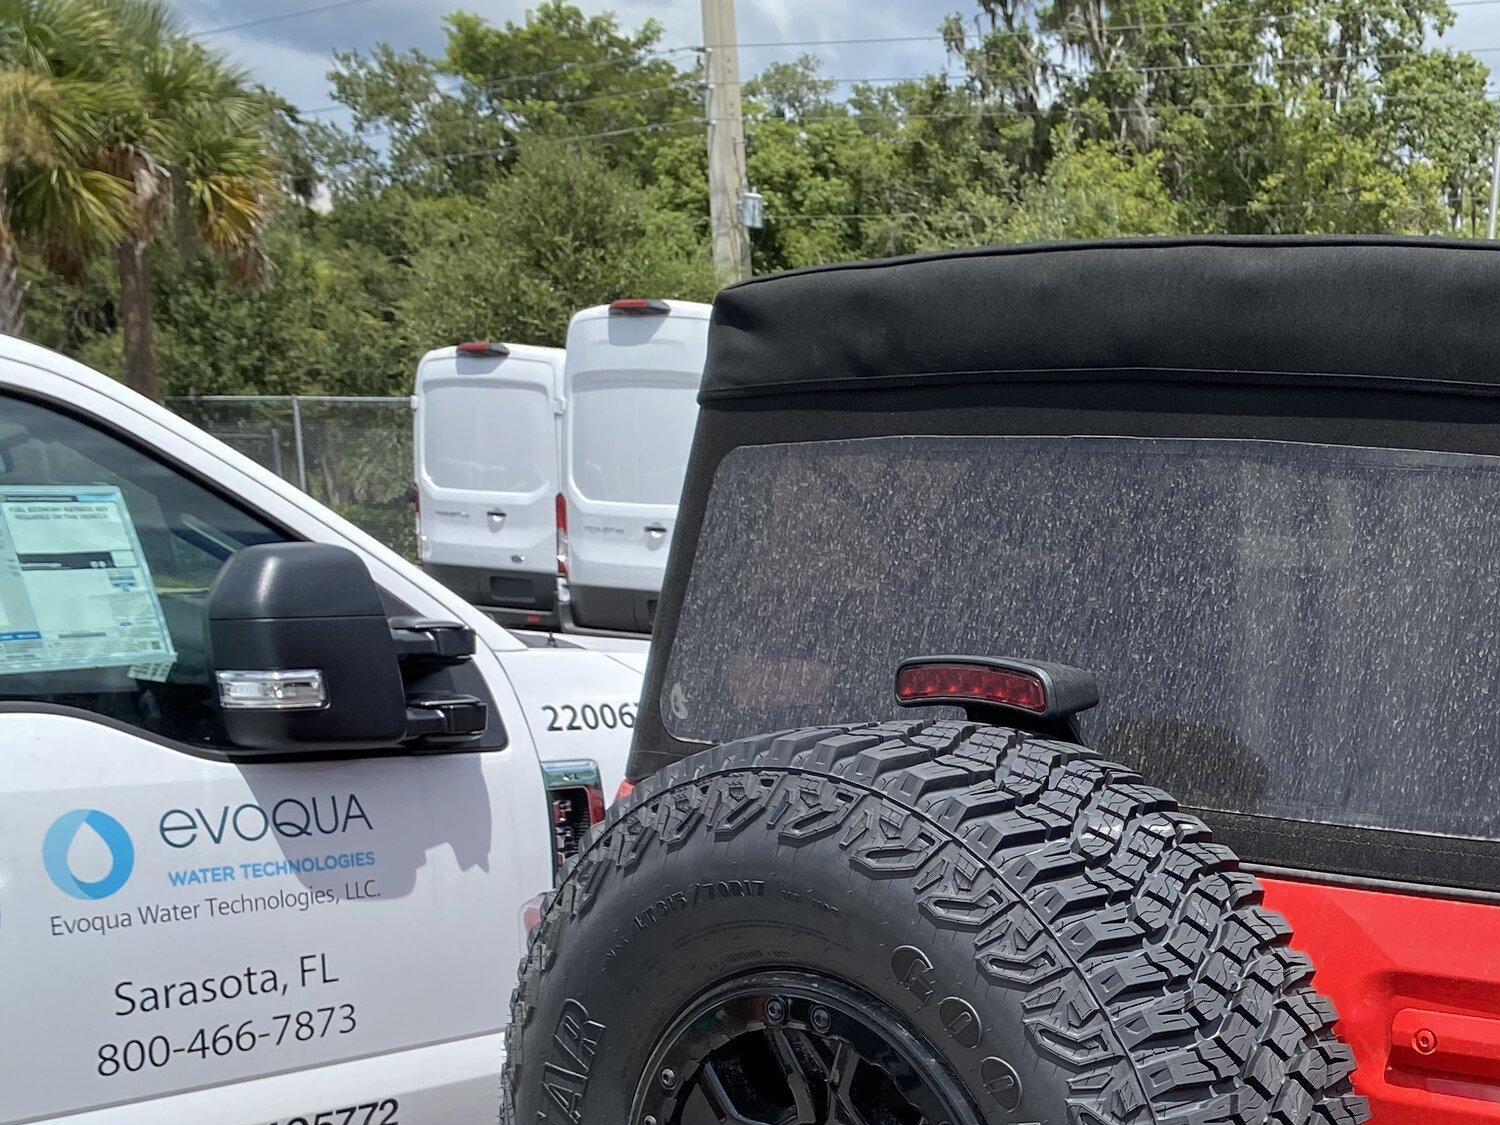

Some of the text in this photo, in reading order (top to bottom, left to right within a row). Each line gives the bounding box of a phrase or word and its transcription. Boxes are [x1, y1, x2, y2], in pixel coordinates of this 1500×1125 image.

[541, 702, 639, 732] 22006
[168, 851, 376, 888] WATER TECHNOLOGIES
[50, 879, 382, 937] Evoqua Water Technologies, LLC.
[114, 952, 339, 1016] Sarasota, FL
[96, 1003, 358, 1077] 800-466-7873
